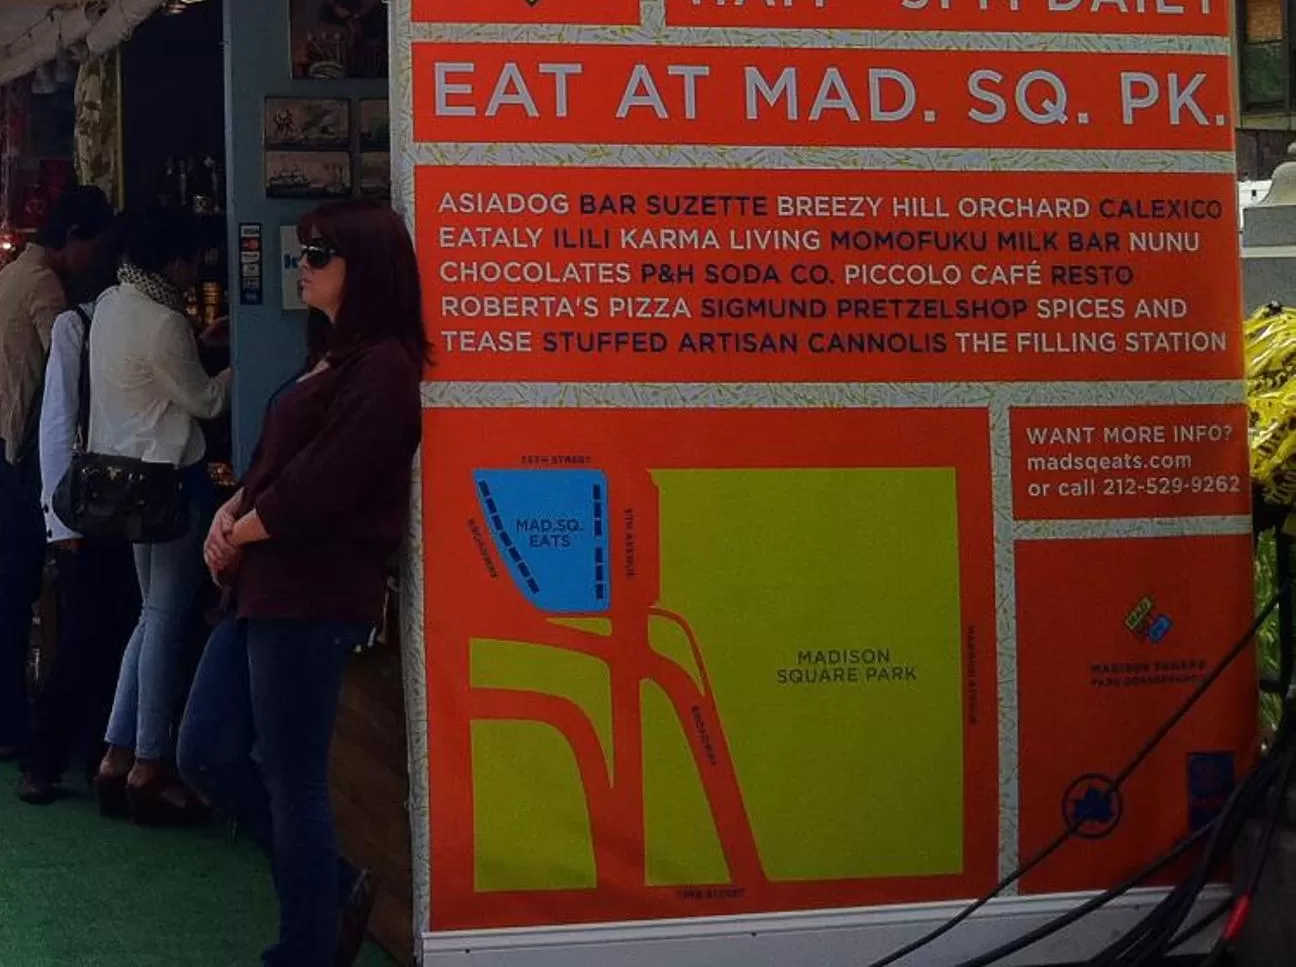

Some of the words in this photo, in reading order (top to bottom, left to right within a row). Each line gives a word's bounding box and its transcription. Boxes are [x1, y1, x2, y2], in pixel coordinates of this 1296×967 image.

[434, 62, 582, 117] EAT
[616, 64, 710, 119] AT
[745, 66, 936, 122] MAD.
[968, 69, 1089, 124] SQ.
[1120, 72, 1225, 126] PK.
[439, 193, 569, 215] ASIADOG
[578, 192, 637, 215] BAR
[647, 193, 768, 217] SUZETTE
[778, 196, 882, 216] BREEZY
[893, 197, 949, 217] HILL
[959, 198, 1089, 218] ORCHARD
[1098, 198, 1224, 221] CALEXICO
[439, 227, 542, 248] EATALY
[553, 228, 611, 248] ILILI
[621, 228, 720, 248] KARMA
[731, 230, 820, 250] LIVING
[831, 228, 989, 253] MOMOFUKU
[996, 231, 1059, 253] MILK
[1068, 229, 1121, 253] BAR
[1130, 232, 1198, 251] NUNU
[440, 261, 630, 283] CHOCOLATES
[641, 261, 696, 284] P&H
[704, 262, 782, 285] SODA
[791, 263, 834, 285] CO.
[845, 264, 961, 285] PICCOLO
[971, 260, 1041, 285] CAFÉ
[1051, 264, 1134, 287] RESTO
[442, 296, 598, 317] ROBERTA'S
[610, 297, 691, 318] PIZZA
[700, 296, 829, 320] SIGMUND
[836, 297, 1030, 321] PRETZELSHOP
[1037, 298, 1125, 318] SPICES
[1135, 299, 1186, 318] AND
[441, 331, 531, 352] TEASE
[542, 330, 669, 354] STUFFED
[679, 330, 801, 353] ARTISAN
[806, 330, 948, 354] CANNOLIS
[955, 333, 1007, 352] THE
[1017, 332, 1116, 352] FILLING
[1126, 332, 1226, 352] STATION
[1026, 427, 1095, 444] WANT
[1104, 426, 1164, 443] MORE
[1174, 424, 1232, 442] INFO?
[1028, 453, 1191, 473] madsqeats.com
[1028, 484, 1050, 496] or
[1059, 478, 1094, 496] call
[1104, 475, 1239, 495] 212-529-9262
[529, 534, 572, 547] EATS
[796, 648, 889, 664] MADISON
[777, 666, 857, 685] SQUARE
[866, 667, 916, 681] PARK
